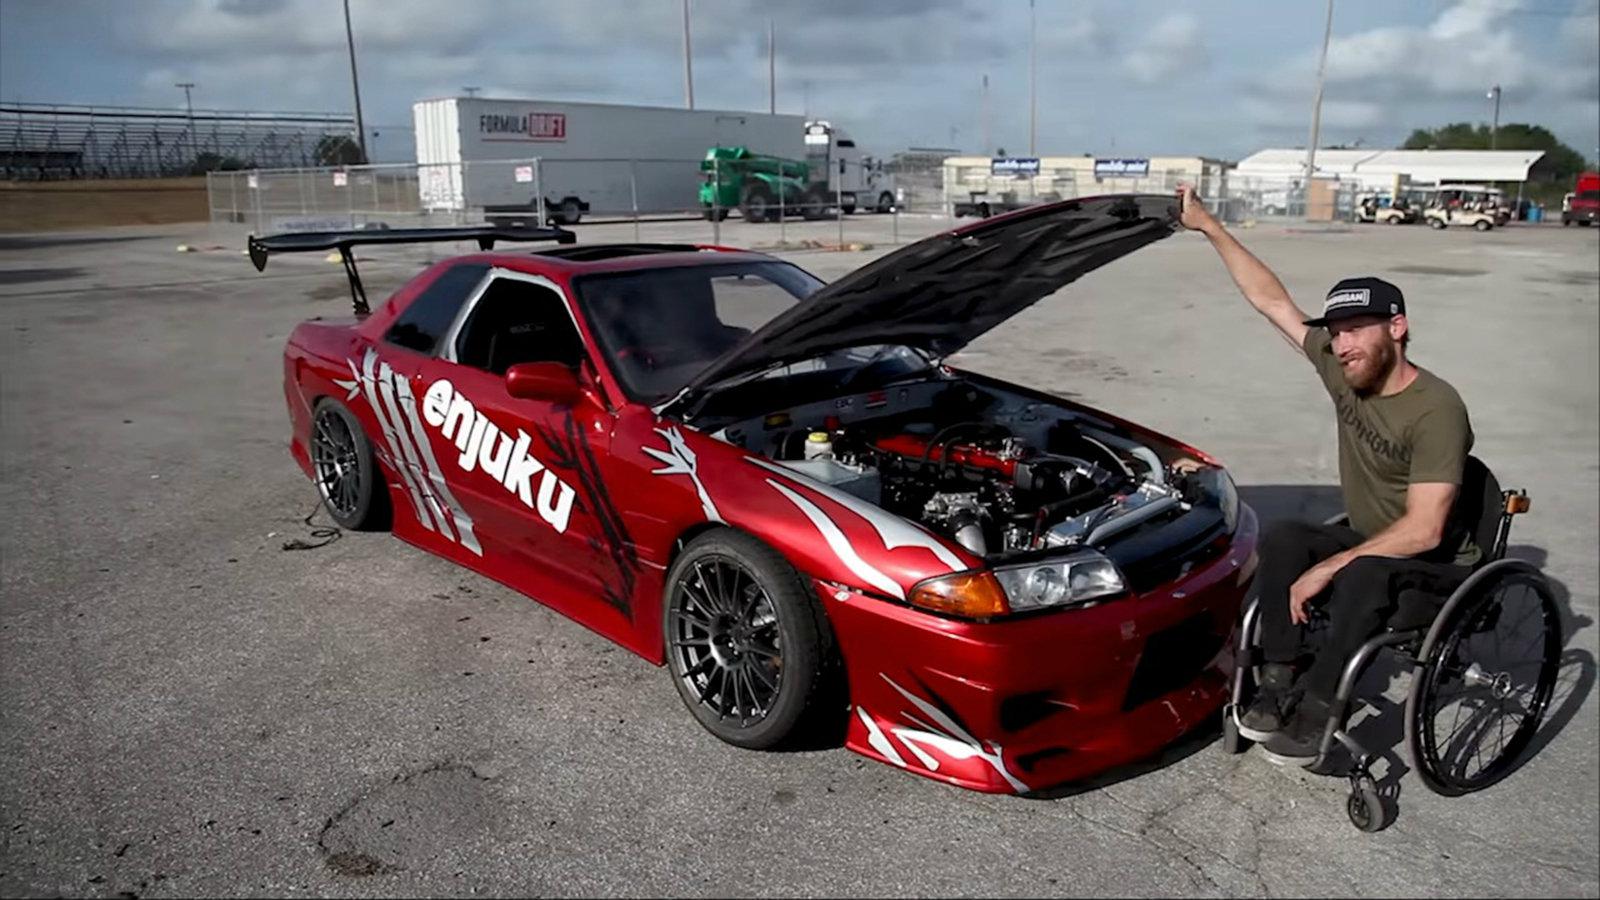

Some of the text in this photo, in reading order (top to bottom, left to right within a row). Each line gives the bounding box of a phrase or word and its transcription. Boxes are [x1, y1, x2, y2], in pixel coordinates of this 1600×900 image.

[480, 114, 565, 136] FORMULA DRIFT
[423, 379, 575, 534] enjuku
